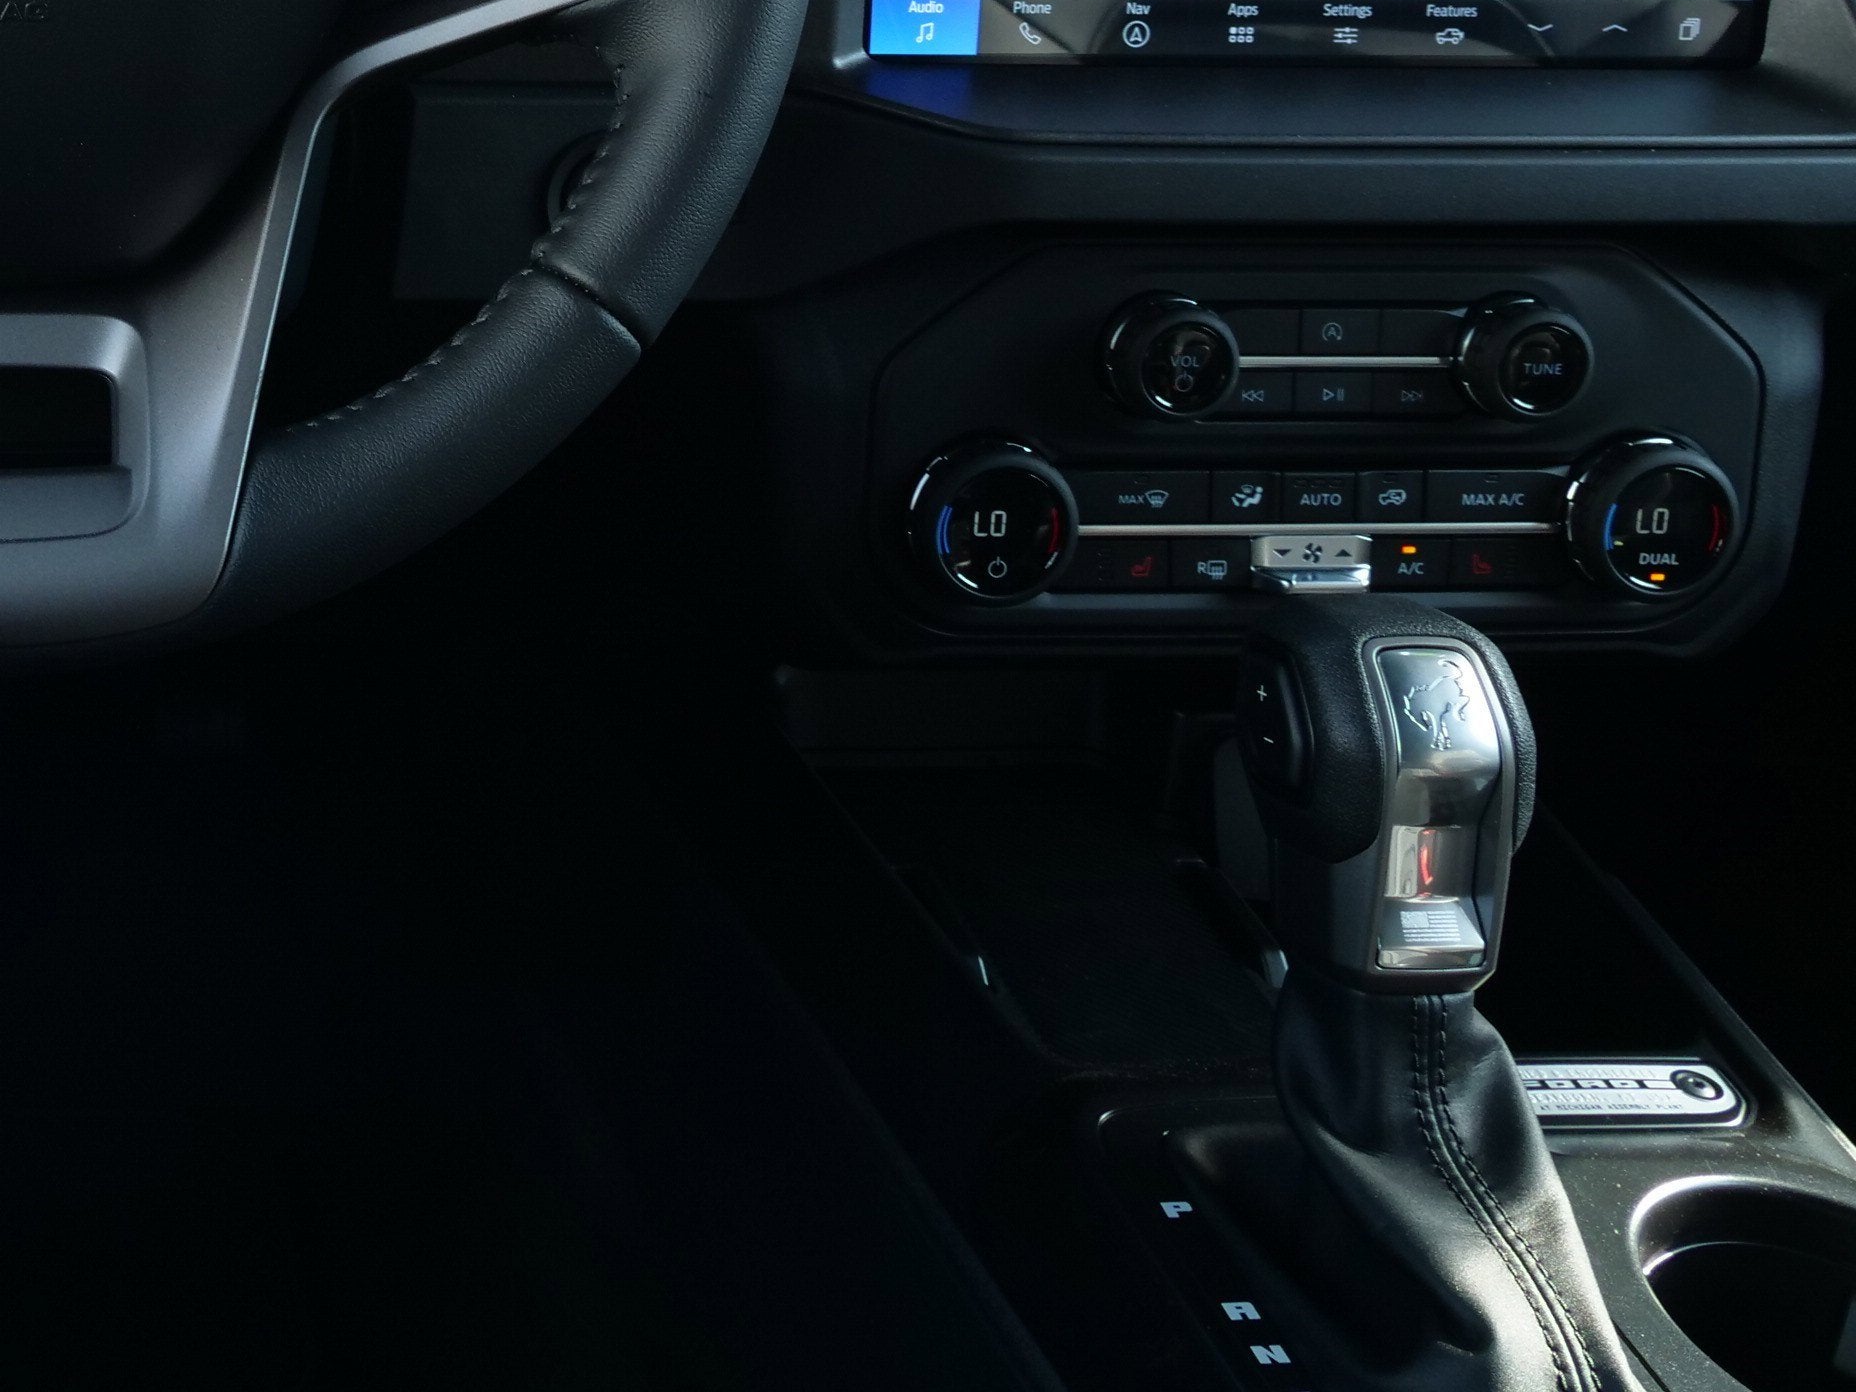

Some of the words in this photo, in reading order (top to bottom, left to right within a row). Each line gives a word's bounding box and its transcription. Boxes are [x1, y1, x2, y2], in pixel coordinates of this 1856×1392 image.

[908, 0, 945, 14] Audio
[1013, 1, 1052, 15] Phone
[1126, 2, 1151, 16] Nav
[1227, 3, 1259, 19] Apps
[1322, 3, 1373, 20] Settings
[1425, 4, 1478, 18] Features
[1170, 355, 1200, 368] VOL
[1523, 362, 1563, 376] TUNE
[1118, 494, 1145, 505] MAX
[1300, 492, 1342, 506] AUTO
[1461, 493, 1495, 506] MAX
[1499, 492, 1525, 507] A/C
[973, 510, 1008, 538] LO
[1635, 508, 1670, 536] LO
[1638, 552, 1680, 567] DUAL
[1397, 561, 1425, 576] A/C
[1160, 1200, 1193, 1219] P
[1250, 1344, 1292, 1365] N
